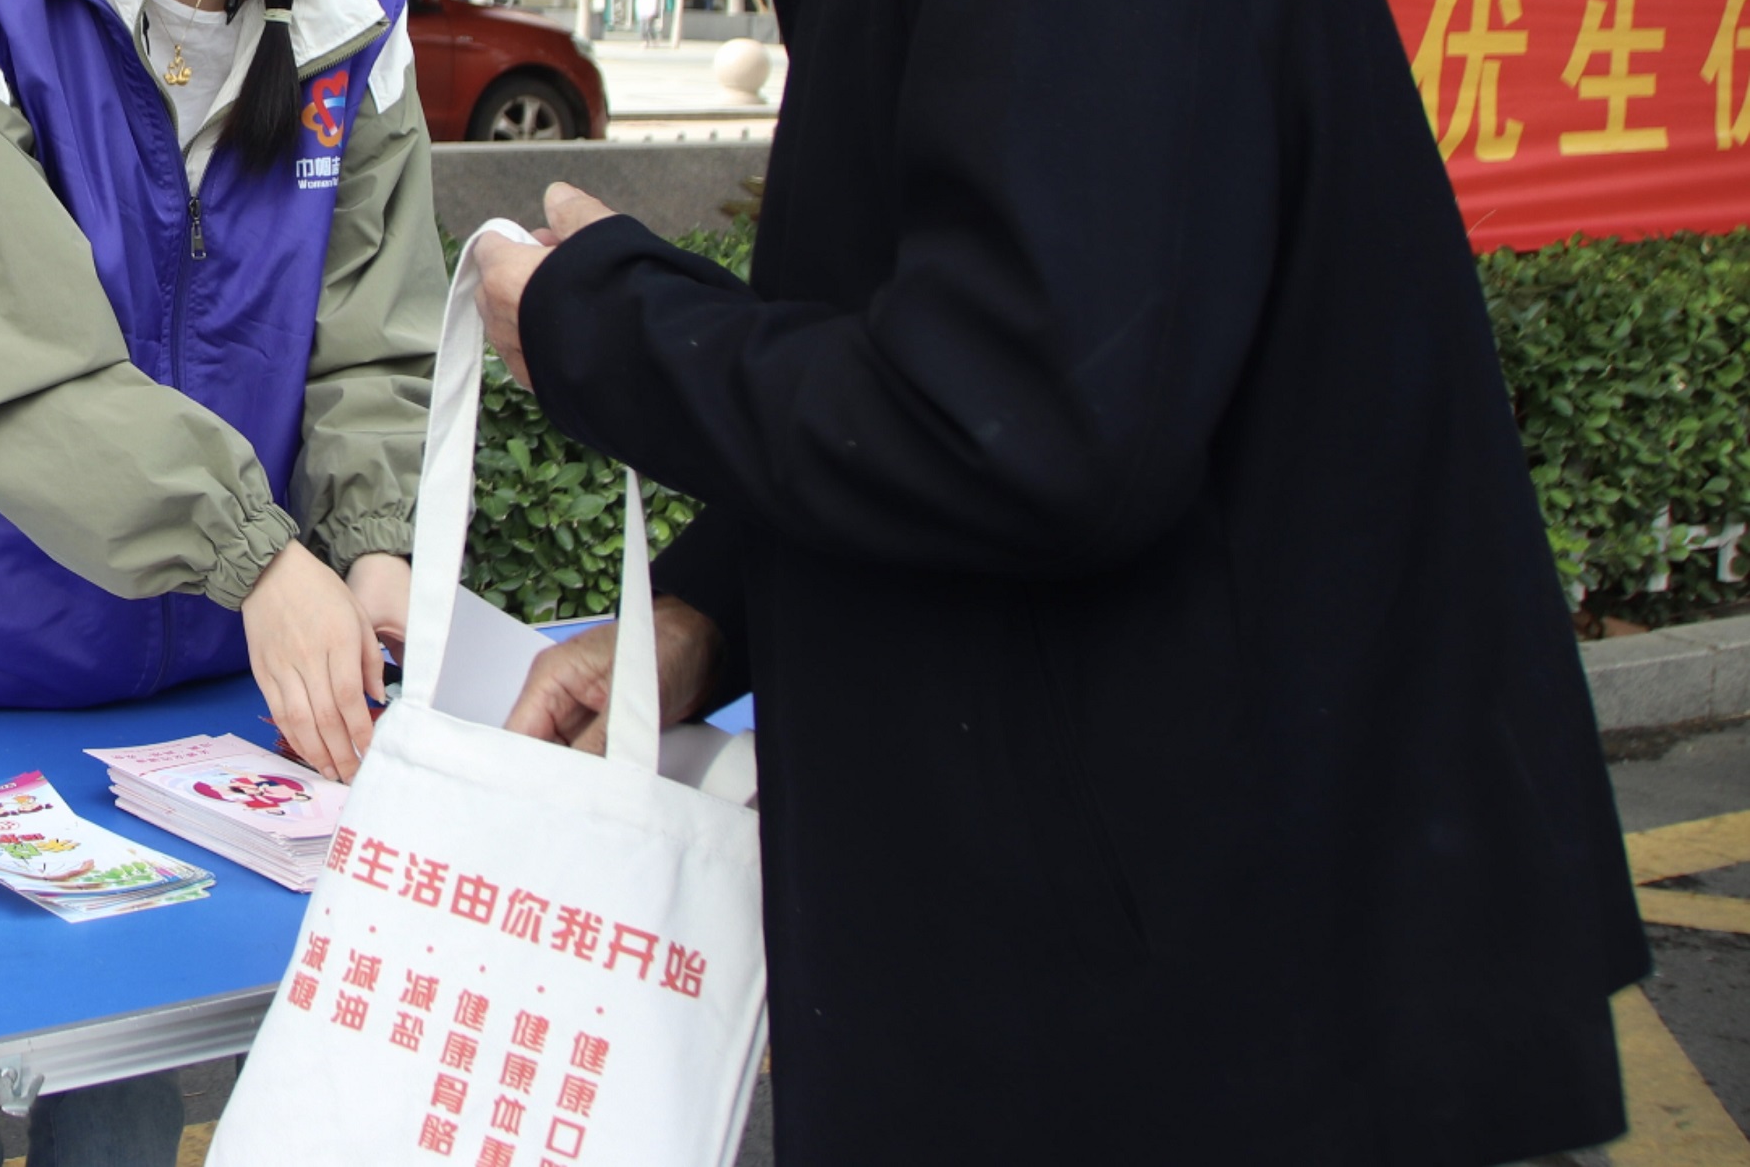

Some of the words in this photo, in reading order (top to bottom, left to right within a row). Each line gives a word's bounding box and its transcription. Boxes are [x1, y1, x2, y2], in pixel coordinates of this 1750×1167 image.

[326, 826, 708, 999] 康生活由你我开始
[536, 1031, 610, 1167] 健康口
